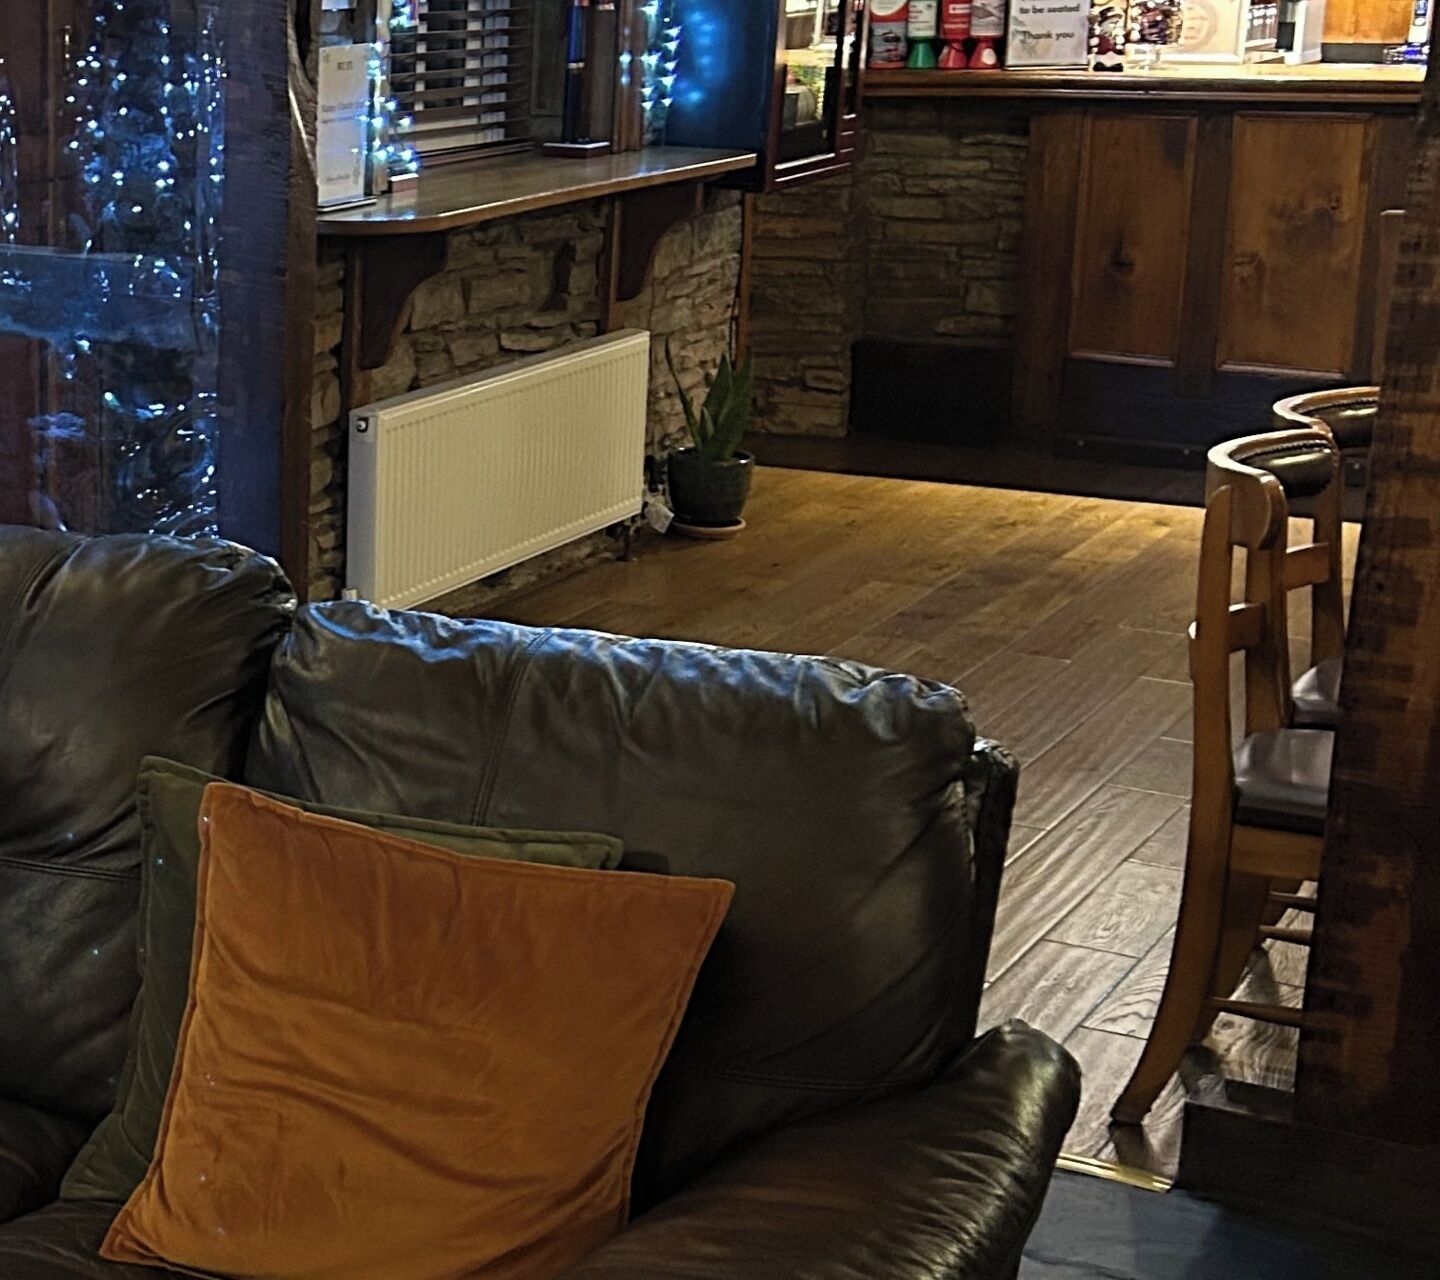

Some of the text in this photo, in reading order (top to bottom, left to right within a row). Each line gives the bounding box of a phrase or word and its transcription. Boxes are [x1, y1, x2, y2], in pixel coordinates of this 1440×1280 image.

[1020, 3, 1080, 14] to be seated
[1022, 31, 1075, 41] Thank you
